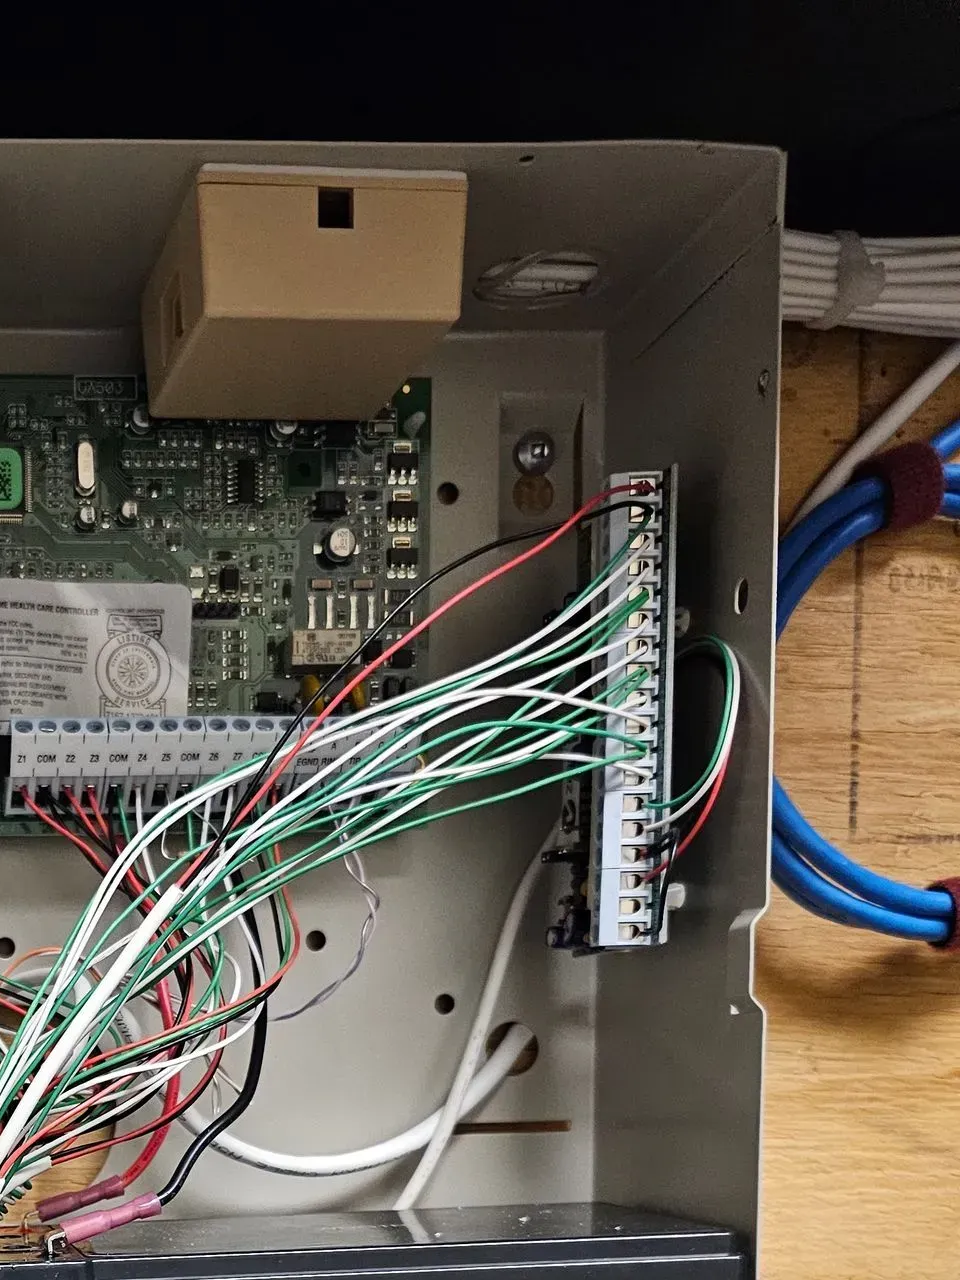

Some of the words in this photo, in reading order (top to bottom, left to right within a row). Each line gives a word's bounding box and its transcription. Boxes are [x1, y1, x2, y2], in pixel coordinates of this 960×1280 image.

[17, 755, 27, 764] Z1
[37, 754, 57, 763] COM
[65, 755, 76, 763] Z2
[89, 754, 100, 763] Z3
[109, 754, 129, 763] COM
[137, 753, 148, 762] Z4
[161, 753, 172, 762] Z5
[180, 753, 201, 762] COM
